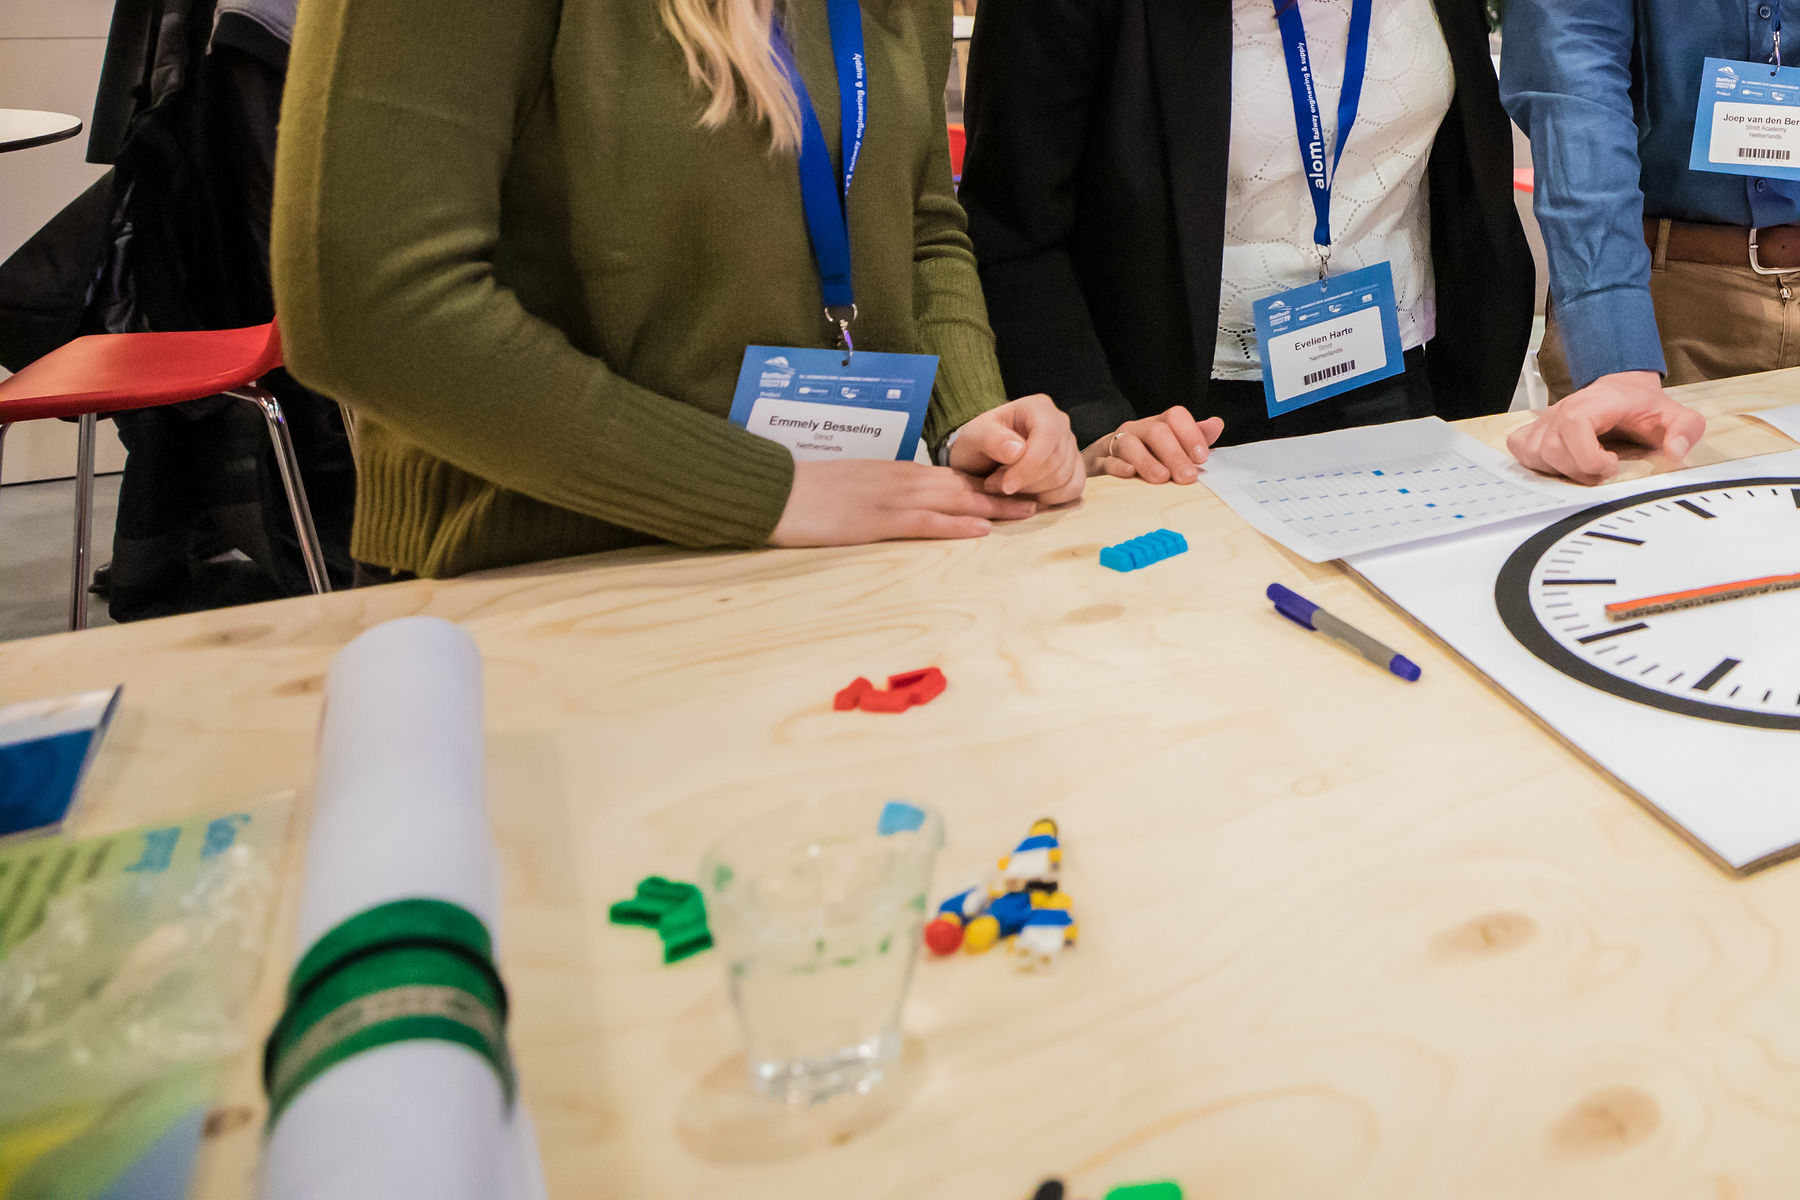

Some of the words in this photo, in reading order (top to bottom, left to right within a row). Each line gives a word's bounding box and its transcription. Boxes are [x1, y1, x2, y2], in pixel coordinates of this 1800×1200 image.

[1296, 41, 1307, 65] supply
[1303, 72, 1316, 113] engineering
[855, 88, 866, 139] engineering
[1722, 113, 1745, 124] Joep
[1747, 116, 1763, 124] van
[1765, 116, 1782, 125] den
[1311, 113, 1319, 140] Railway
[1308, 140, 1325, 190] alom
[1294, 335, 1328, 351] Evelien
[1329, 326, 1354, 341] Harte
[768, 415, 820, 432] Emmely
[822, 419, 882, 438] Besseling
[795, 441, 843, 453] Netherlands
